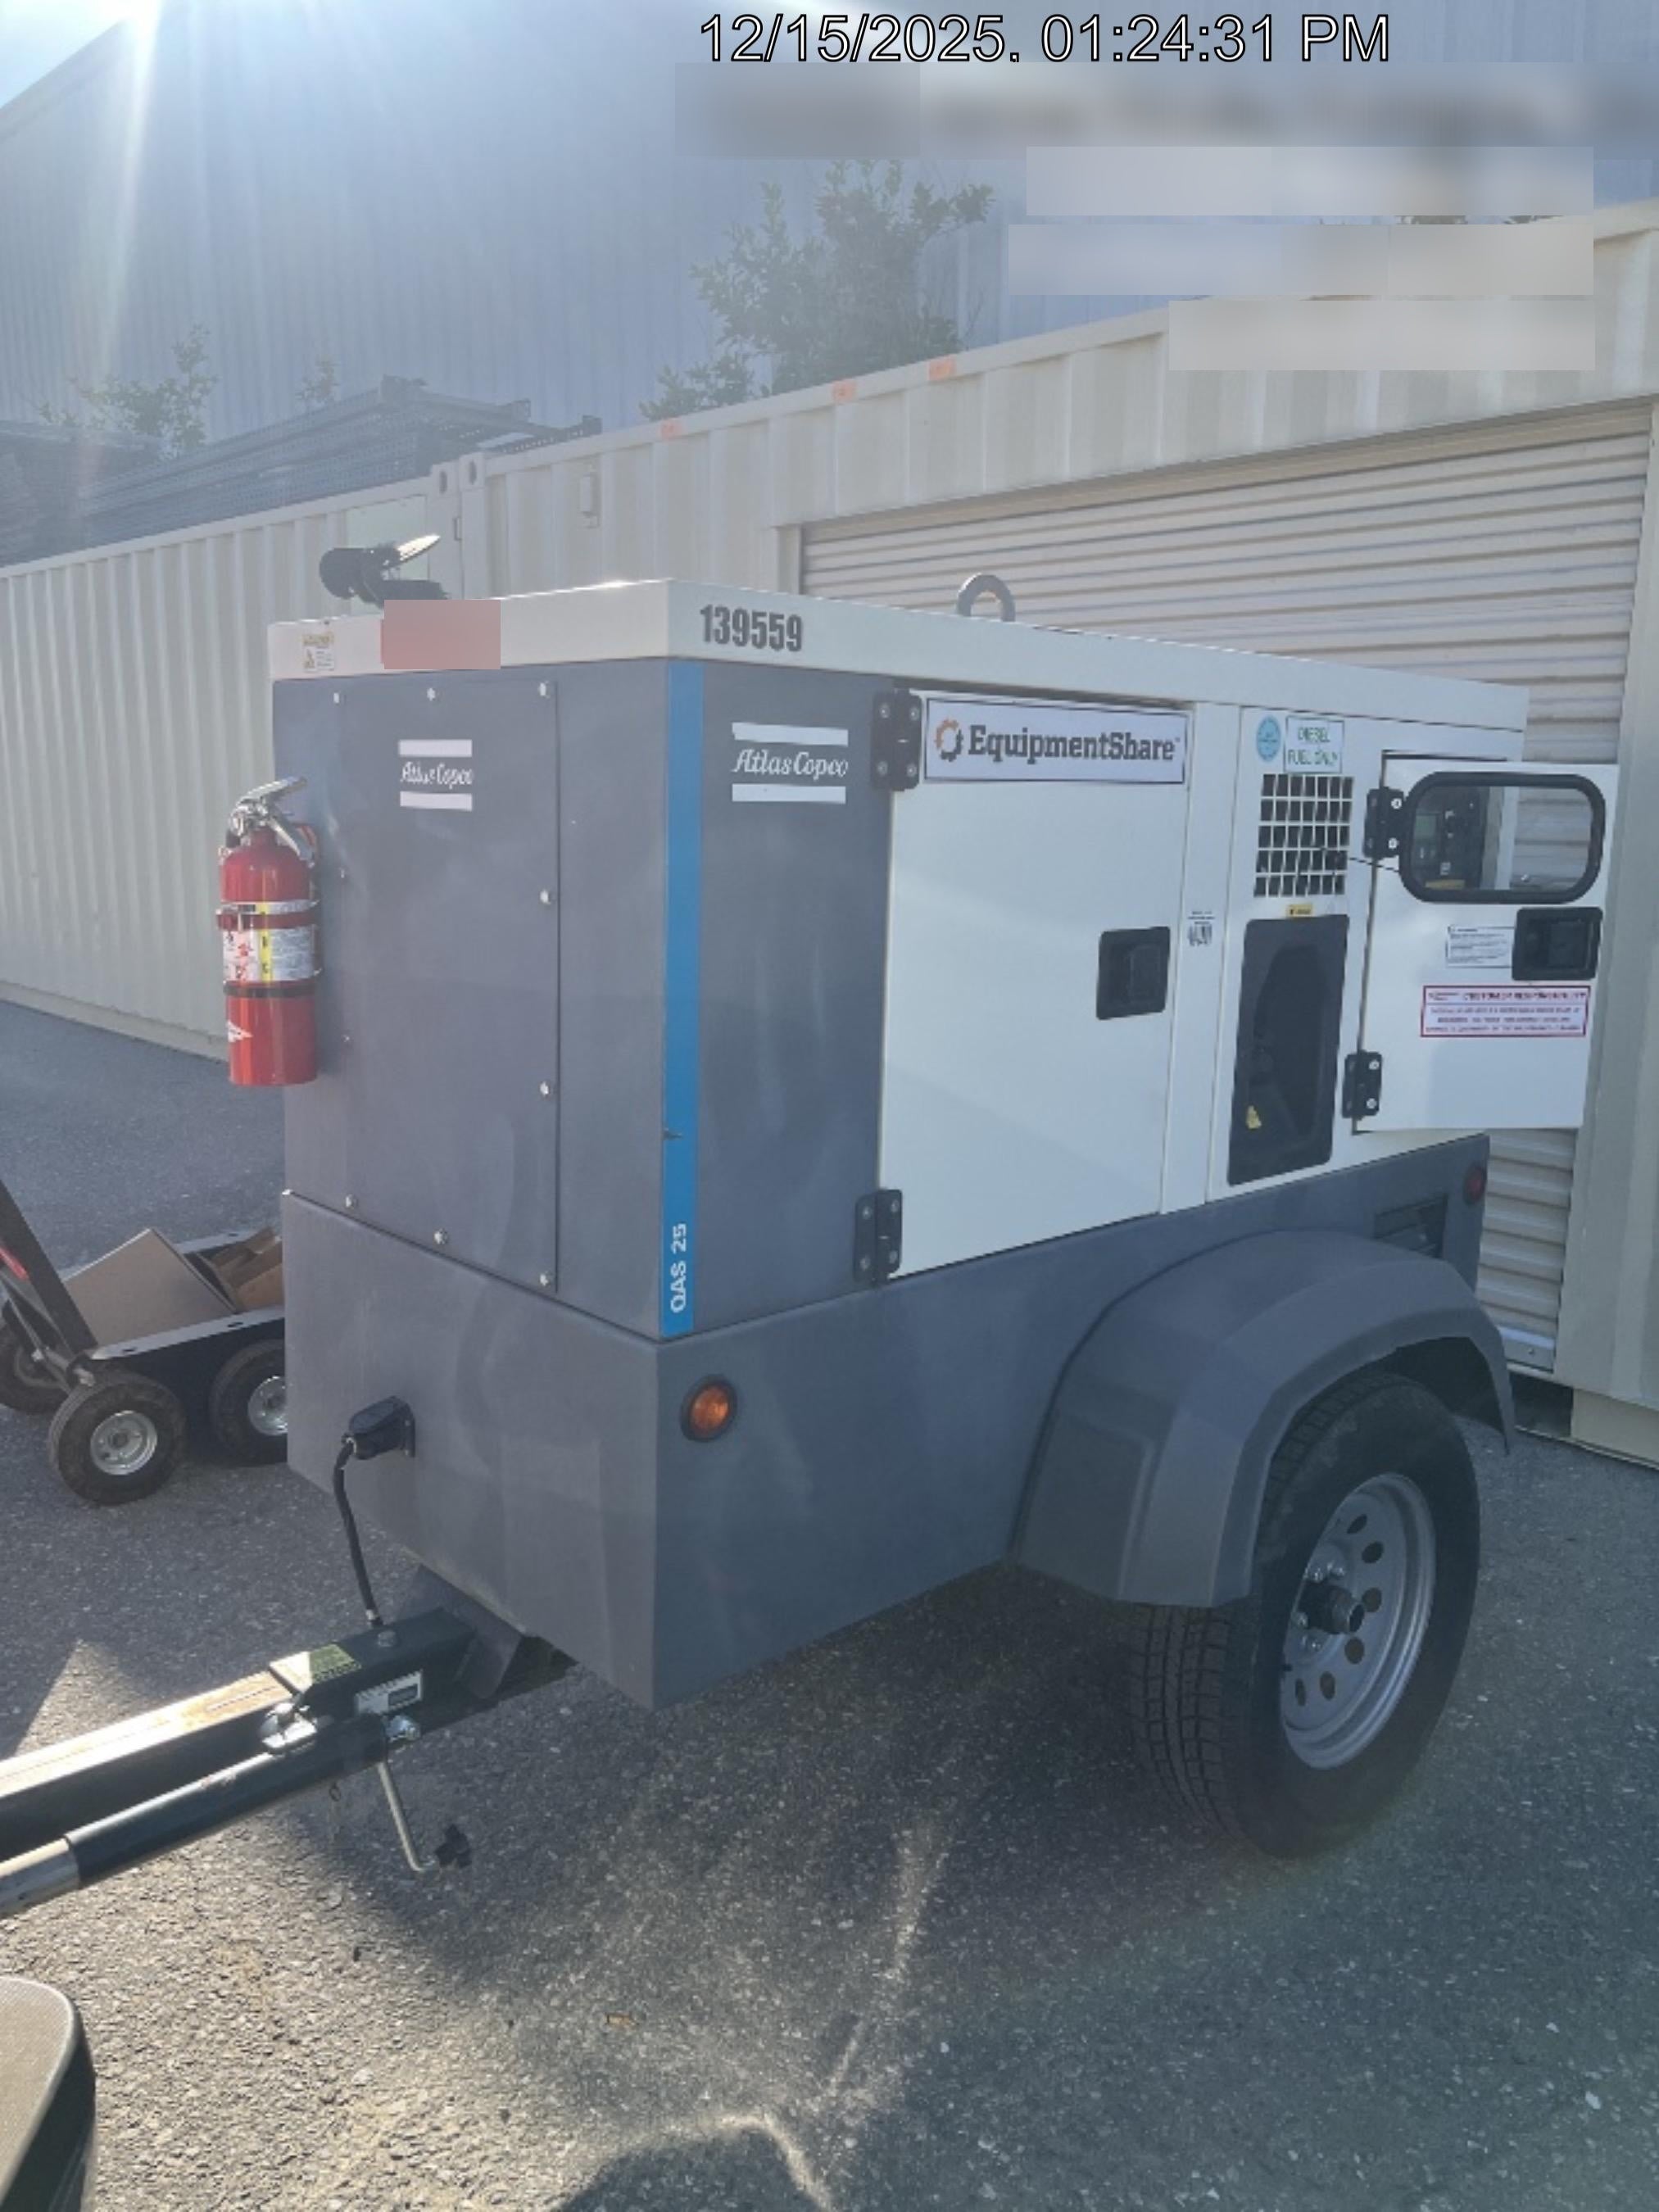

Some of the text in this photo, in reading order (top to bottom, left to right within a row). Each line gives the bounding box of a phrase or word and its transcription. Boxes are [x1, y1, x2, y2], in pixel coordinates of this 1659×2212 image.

[700, 604, 804, 652] 139559
[968, 725, 1175, 764] EquipmentShare
[670, 1222, 687, 1313] QAS 25
